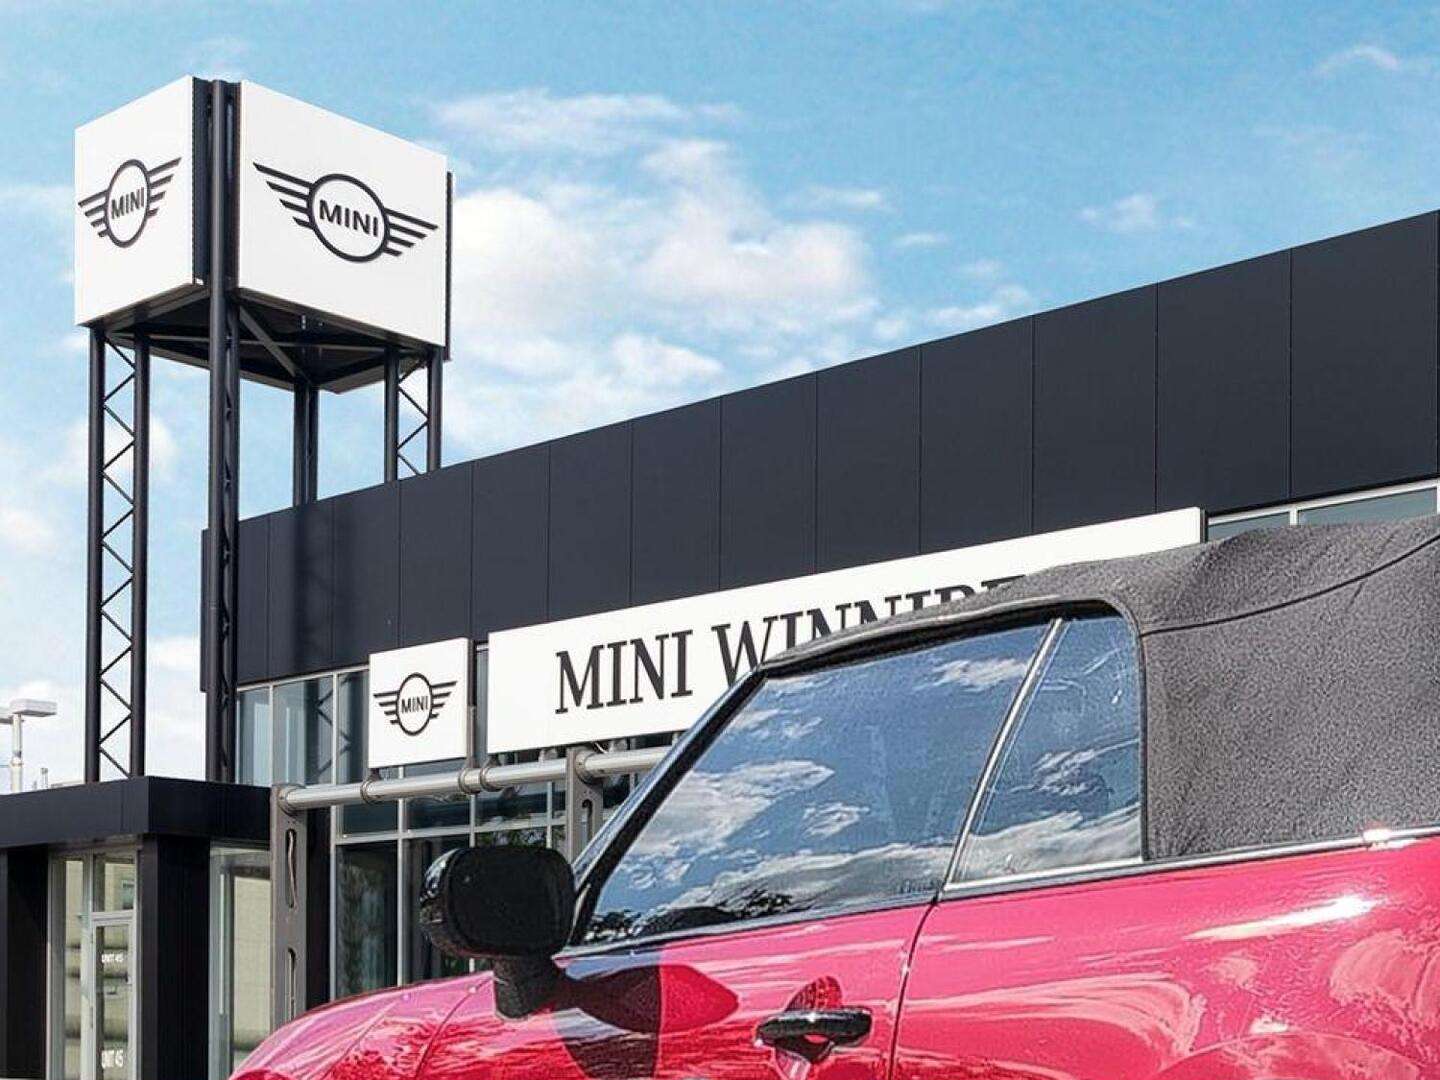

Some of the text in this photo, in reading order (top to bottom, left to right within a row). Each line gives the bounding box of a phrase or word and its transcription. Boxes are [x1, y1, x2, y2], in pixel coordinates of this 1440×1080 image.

[111, 186, 145, 220] MINI
[319, 199, 379, 237] MINI
[555, 629, 693, 714] MINI
[401, 695, 429, 714] MINI
